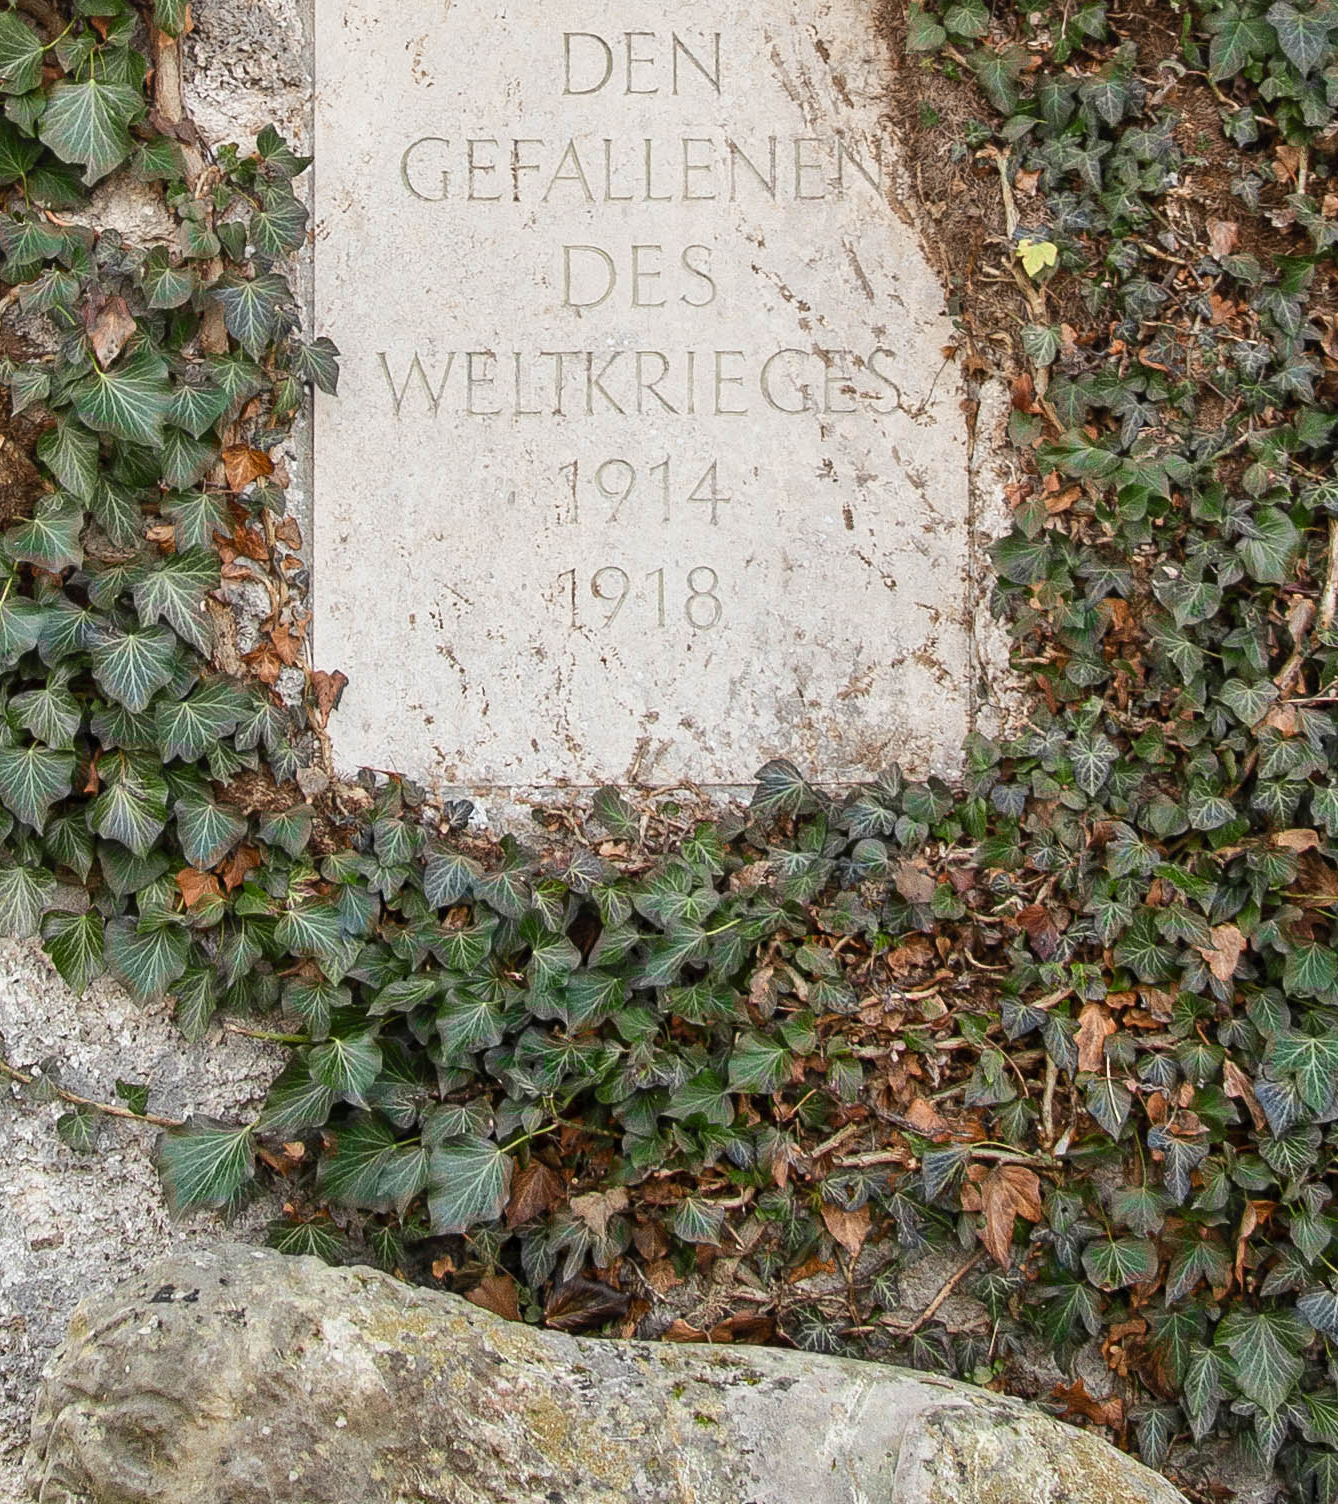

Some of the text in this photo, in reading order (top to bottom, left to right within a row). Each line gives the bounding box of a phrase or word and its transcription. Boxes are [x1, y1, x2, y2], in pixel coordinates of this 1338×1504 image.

[562, 32, 723, 96] DEN
[400, 136, 884, 203] GEFALLENEN
[561, 244, 716, 310] DES
[378, 348, 903, 417] WELTKRIEGES
[558, 458, 732, 526] 1914
[558, 565, 724, 632] 1918
